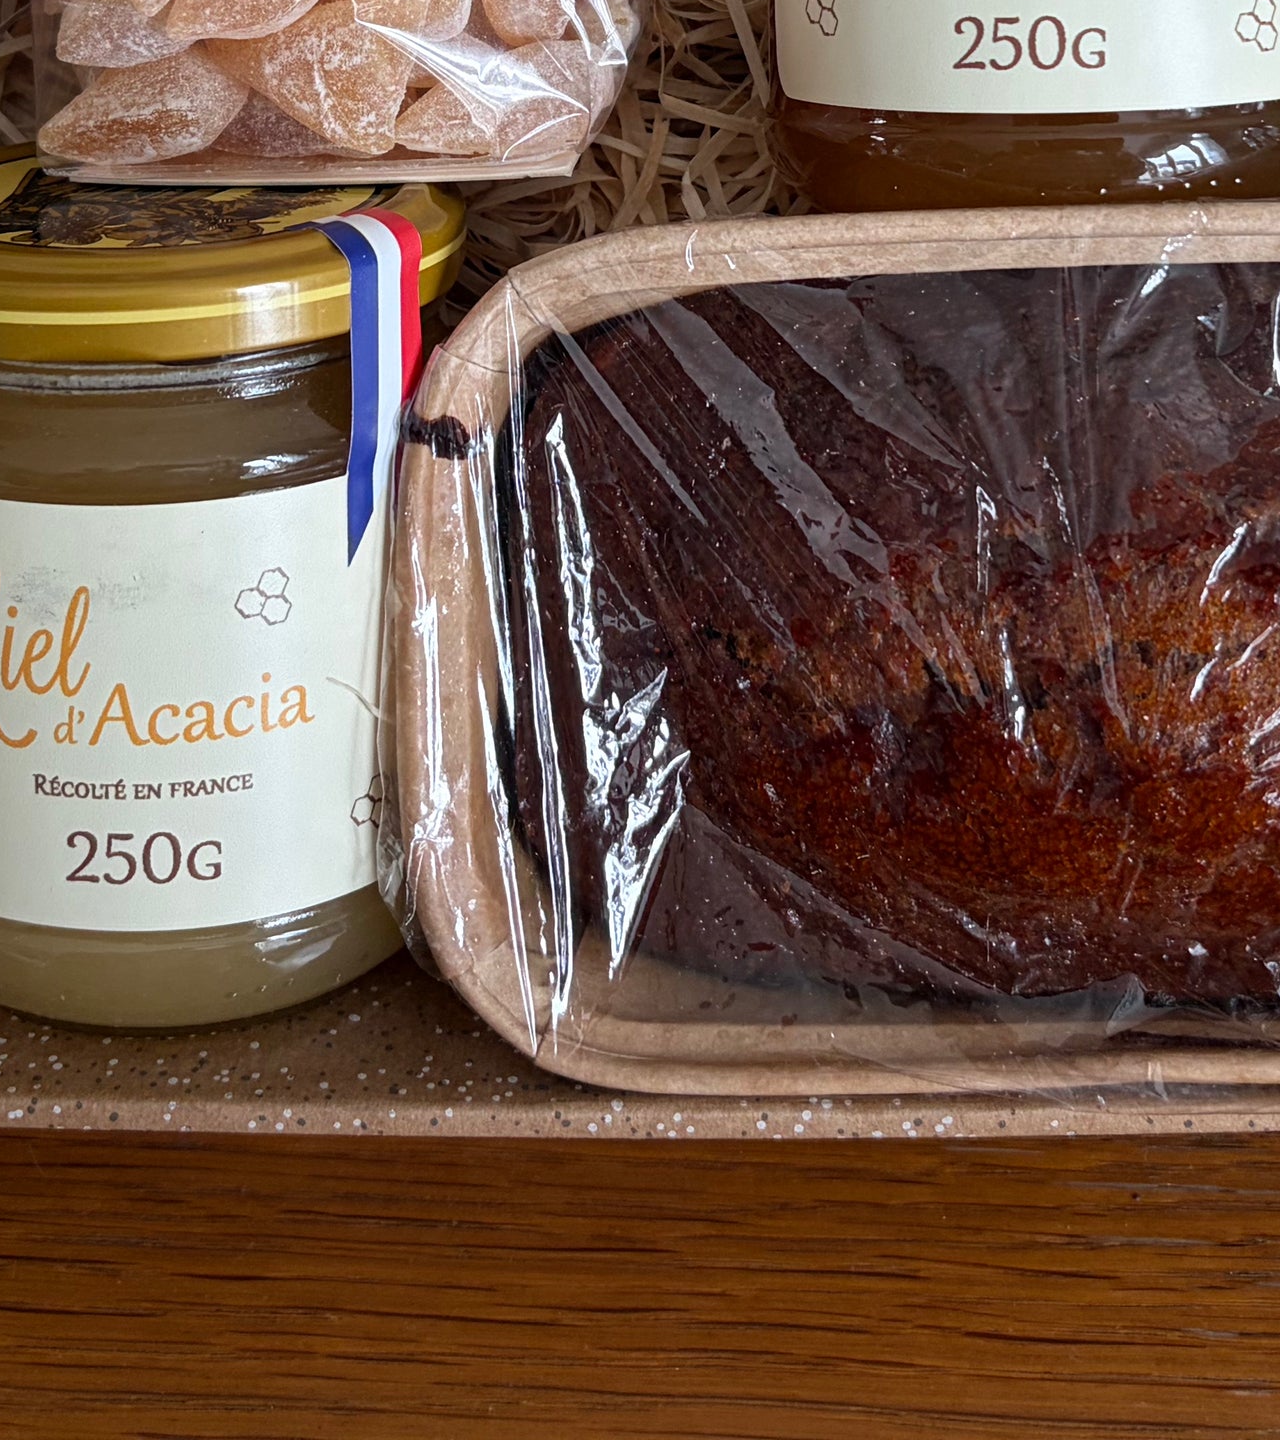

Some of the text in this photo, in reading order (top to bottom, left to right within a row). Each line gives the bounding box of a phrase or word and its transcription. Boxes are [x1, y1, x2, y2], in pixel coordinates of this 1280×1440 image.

[952, 15, 1107, 71] 250G
[32, 772, 254, 801] RÉCOLTÉ EN FRANCE
[65, 830, 223, 886] 250G
